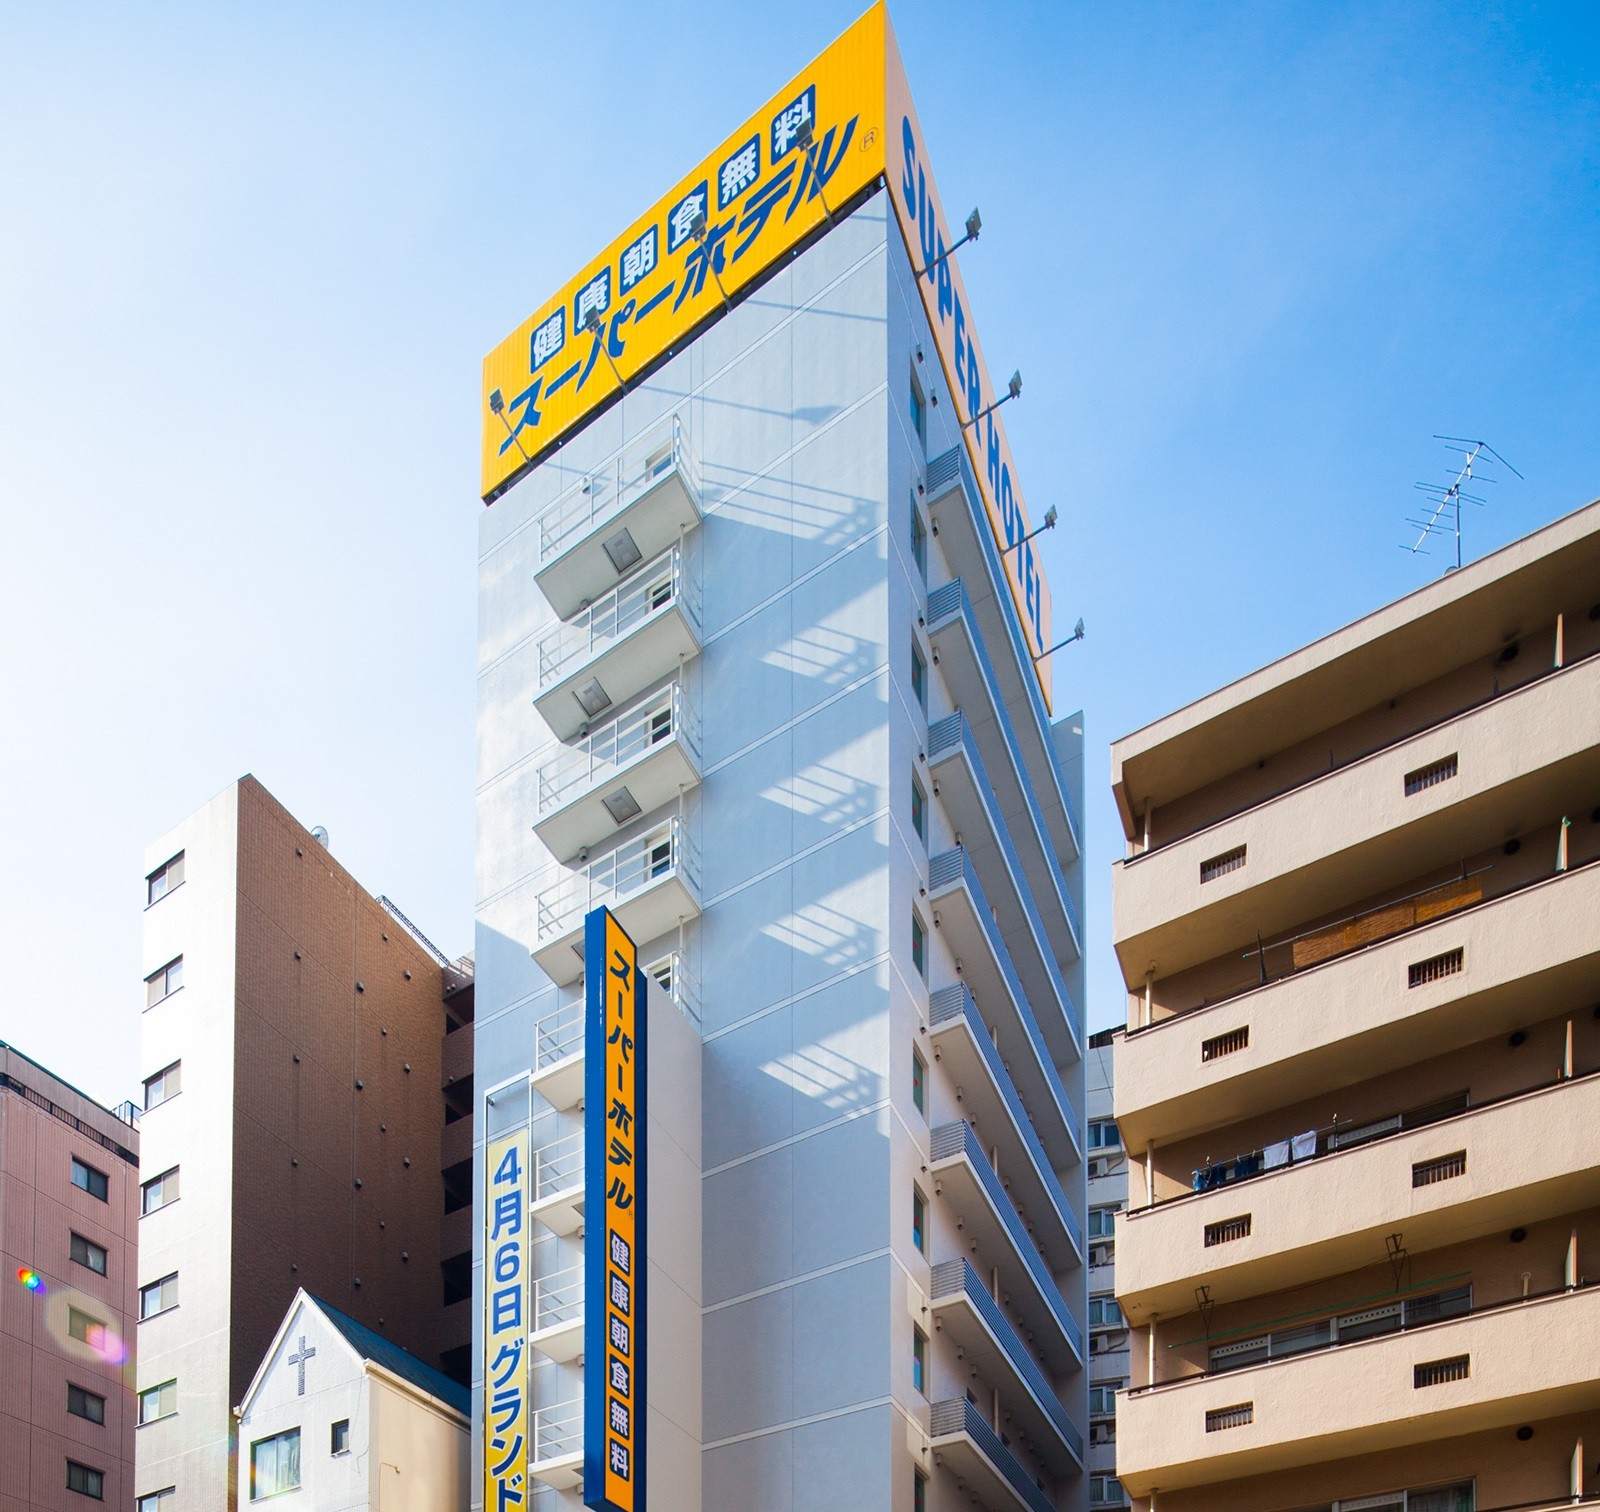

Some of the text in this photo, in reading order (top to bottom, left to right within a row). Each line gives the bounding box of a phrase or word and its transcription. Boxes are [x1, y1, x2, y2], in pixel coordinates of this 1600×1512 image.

[498, 113, 860, 455] スーパーホテル
[532, 92, 812, 368] 健康朝食無料
[902, 115, 1044, 654] SUPER HOTEL
[607, 949, 634, 1210] スーパーホテル
[490, 1146, 525, 1512] 4月6日グランド
[611, 1233, 630, 1478] 健康朝食無料
